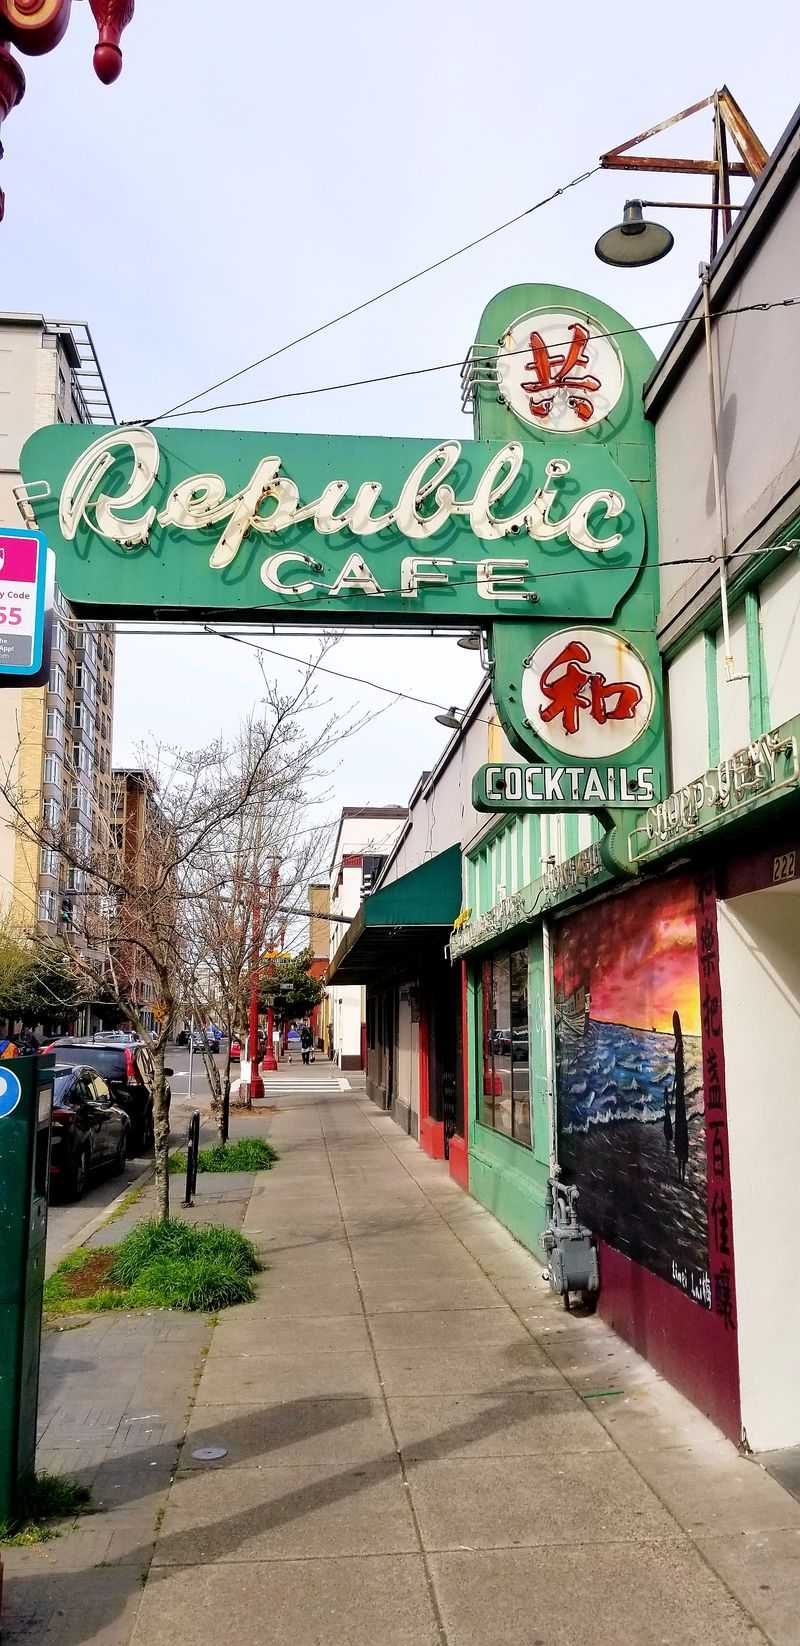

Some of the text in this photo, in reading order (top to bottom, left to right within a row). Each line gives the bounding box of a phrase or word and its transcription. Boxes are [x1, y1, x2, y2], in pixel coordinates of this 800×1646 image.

[520, 323, 602, 422] 共
[60, 426, 625, 569] Republic
[7, 591, 31, 600] Code
[260, 551, 540, 601] CAFE
[539, 641, 643, 734] 和
[485, 766, 654, 801] COCKTAILS
[774, 852, 795, 881] 222
